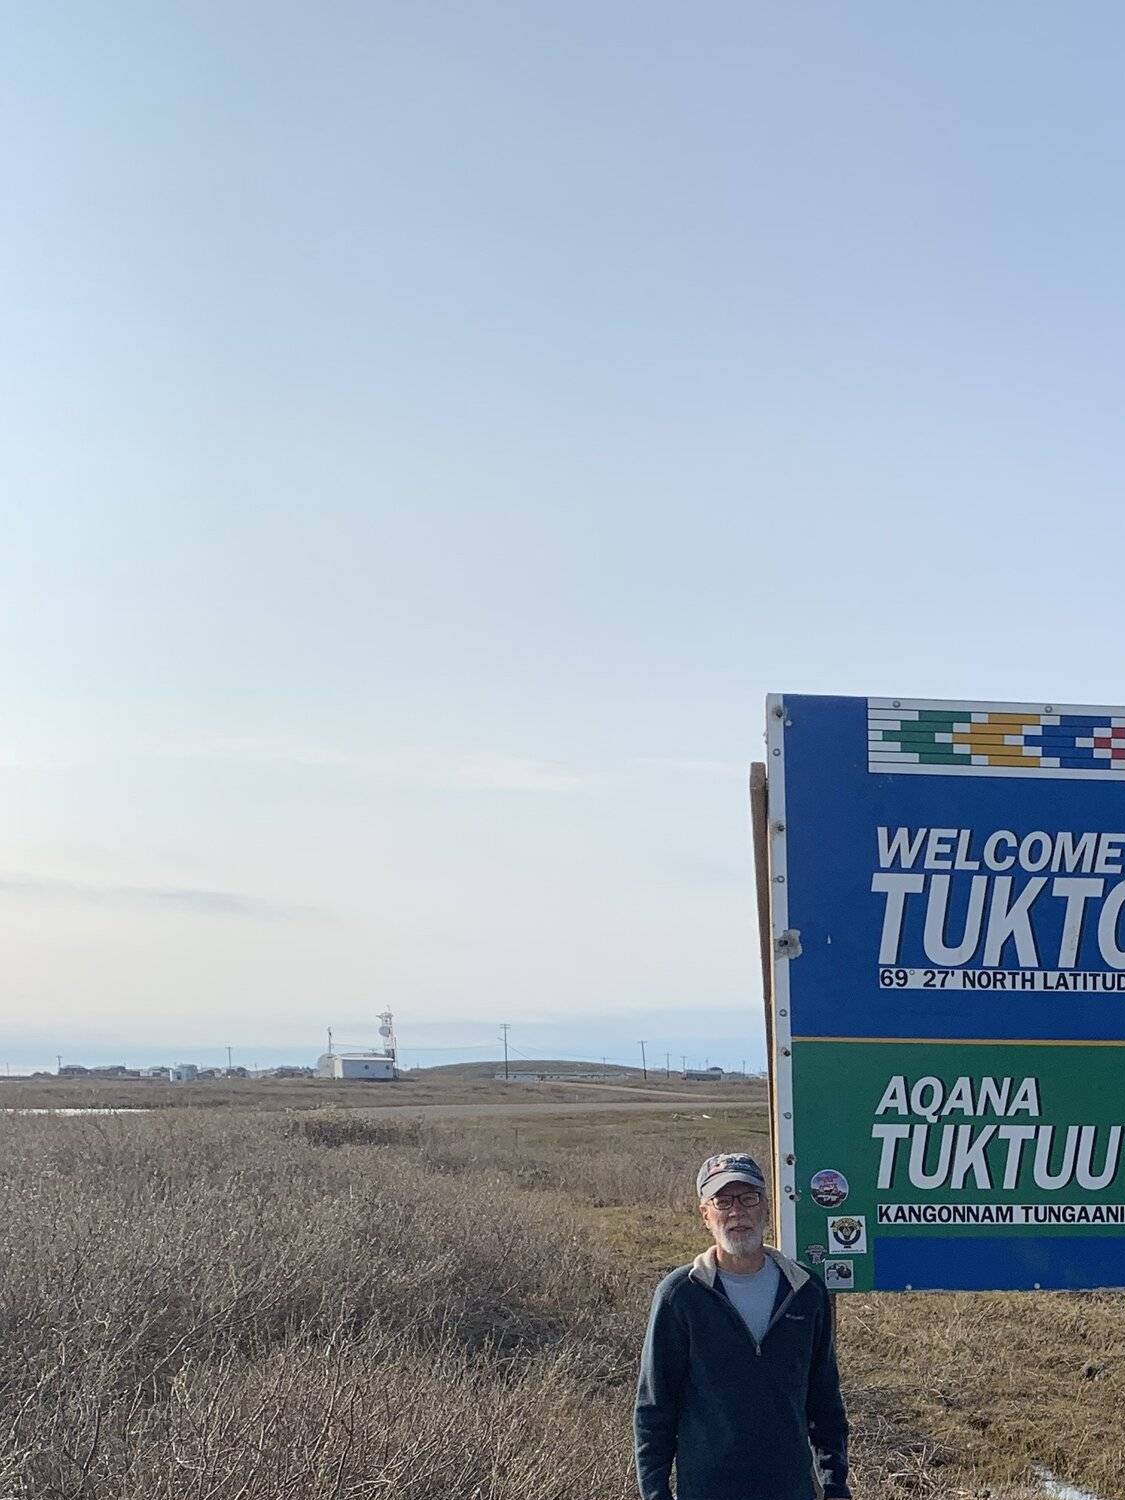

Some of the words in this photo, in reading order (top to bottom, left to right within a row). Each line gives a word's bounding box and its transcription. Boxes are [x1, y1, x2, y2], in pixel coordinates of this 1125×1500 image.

[962, 971, 1035, 990] NORTH
[875, 1075, 1040, 1123] AQANA
[878, 1205, 1014, 1223] KANGONNAM
